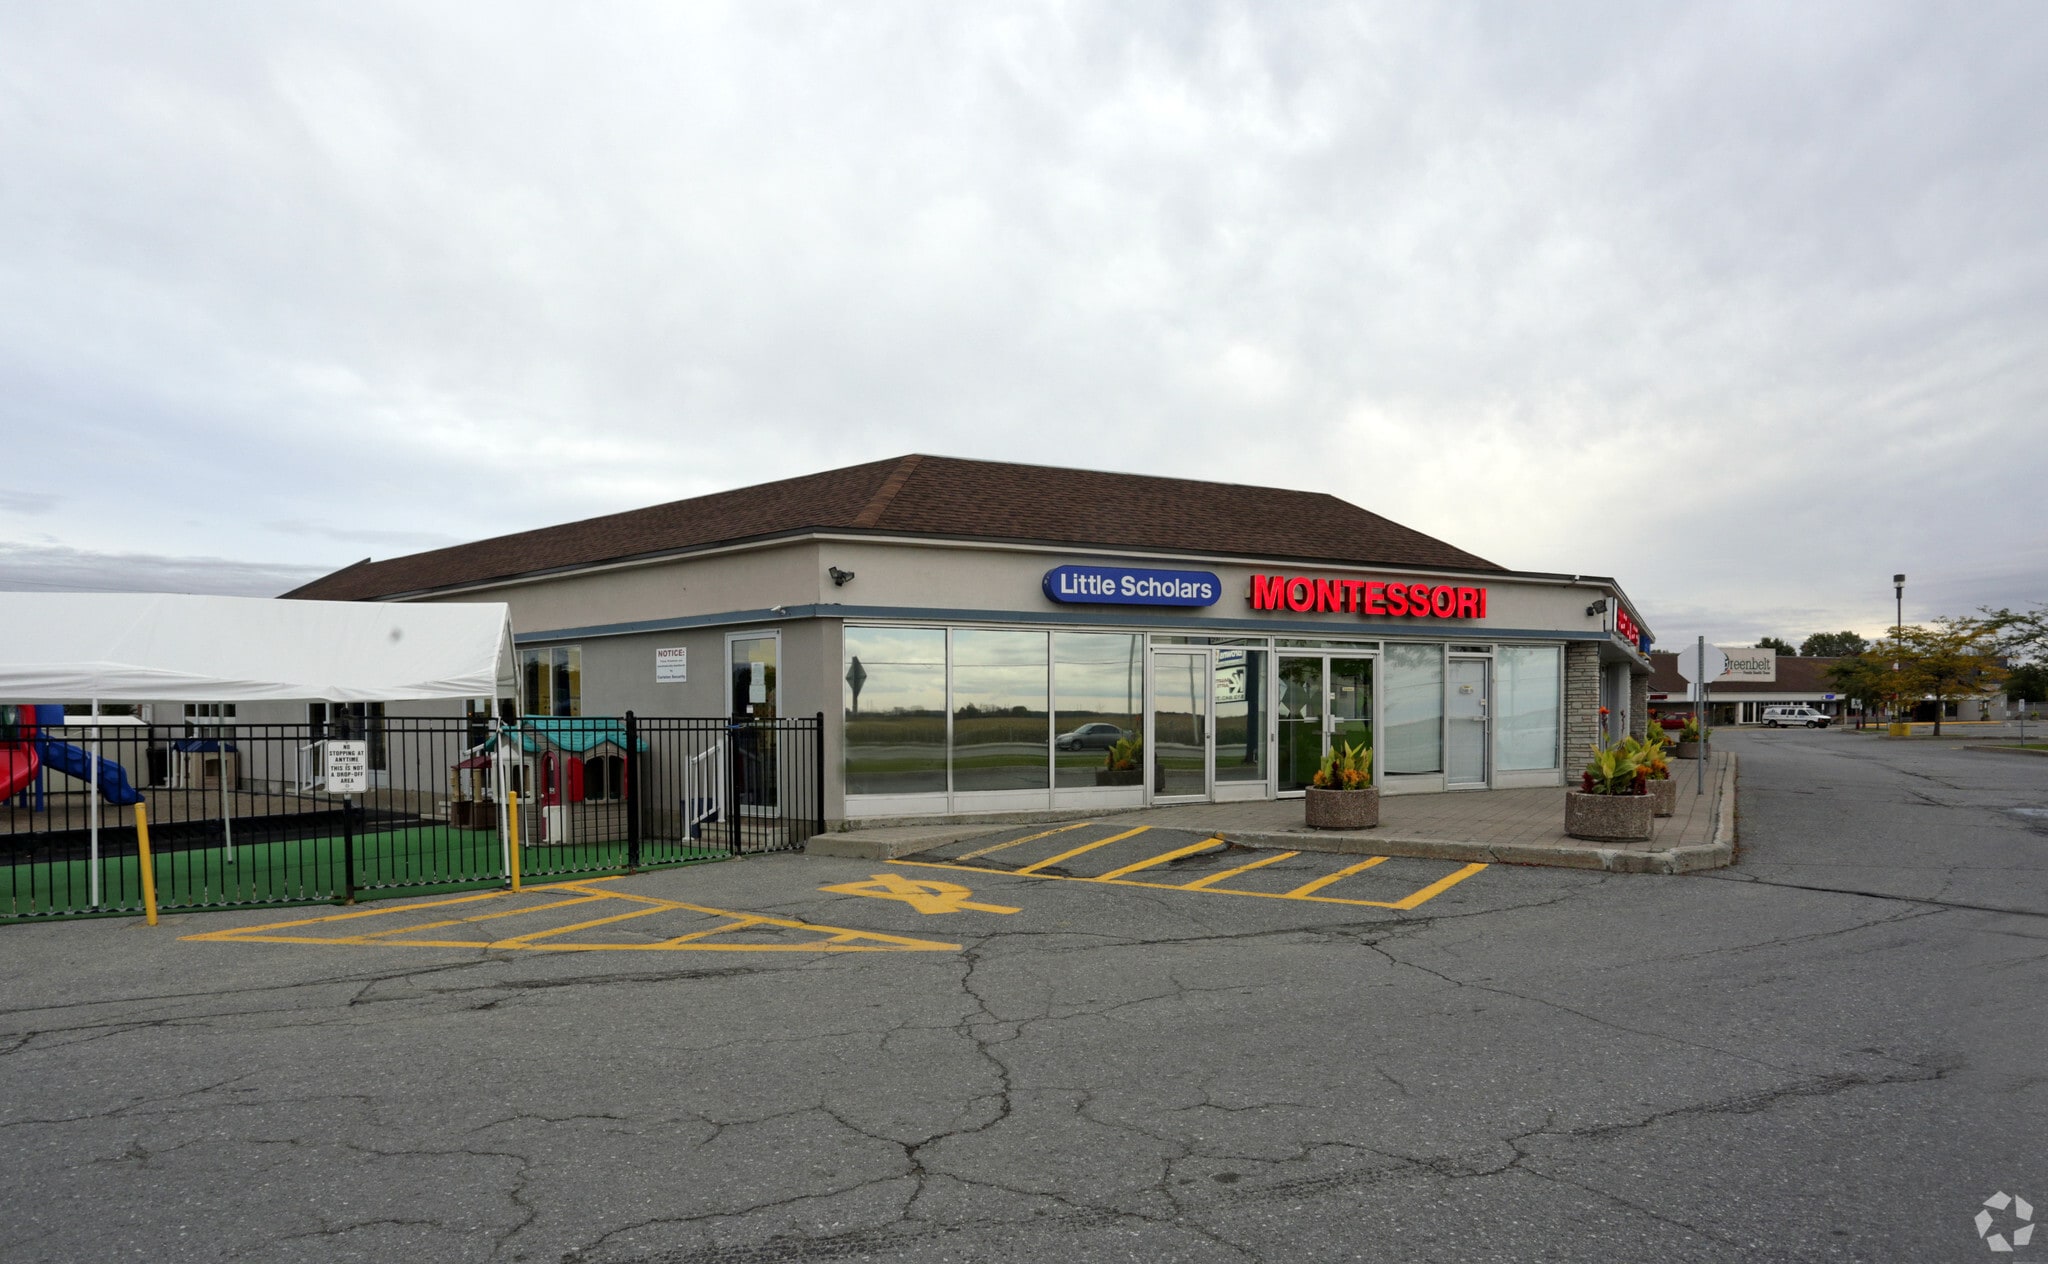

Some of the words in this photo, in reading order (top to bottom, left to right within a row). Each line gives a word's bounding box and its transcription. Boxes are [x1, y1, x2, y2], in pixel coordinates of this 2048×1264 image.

[1059, 572, 1116, 596] Little
[1121, 575, 1213, 600] Scholars
[1250, 574, 1487, 619] MONTESSORI
